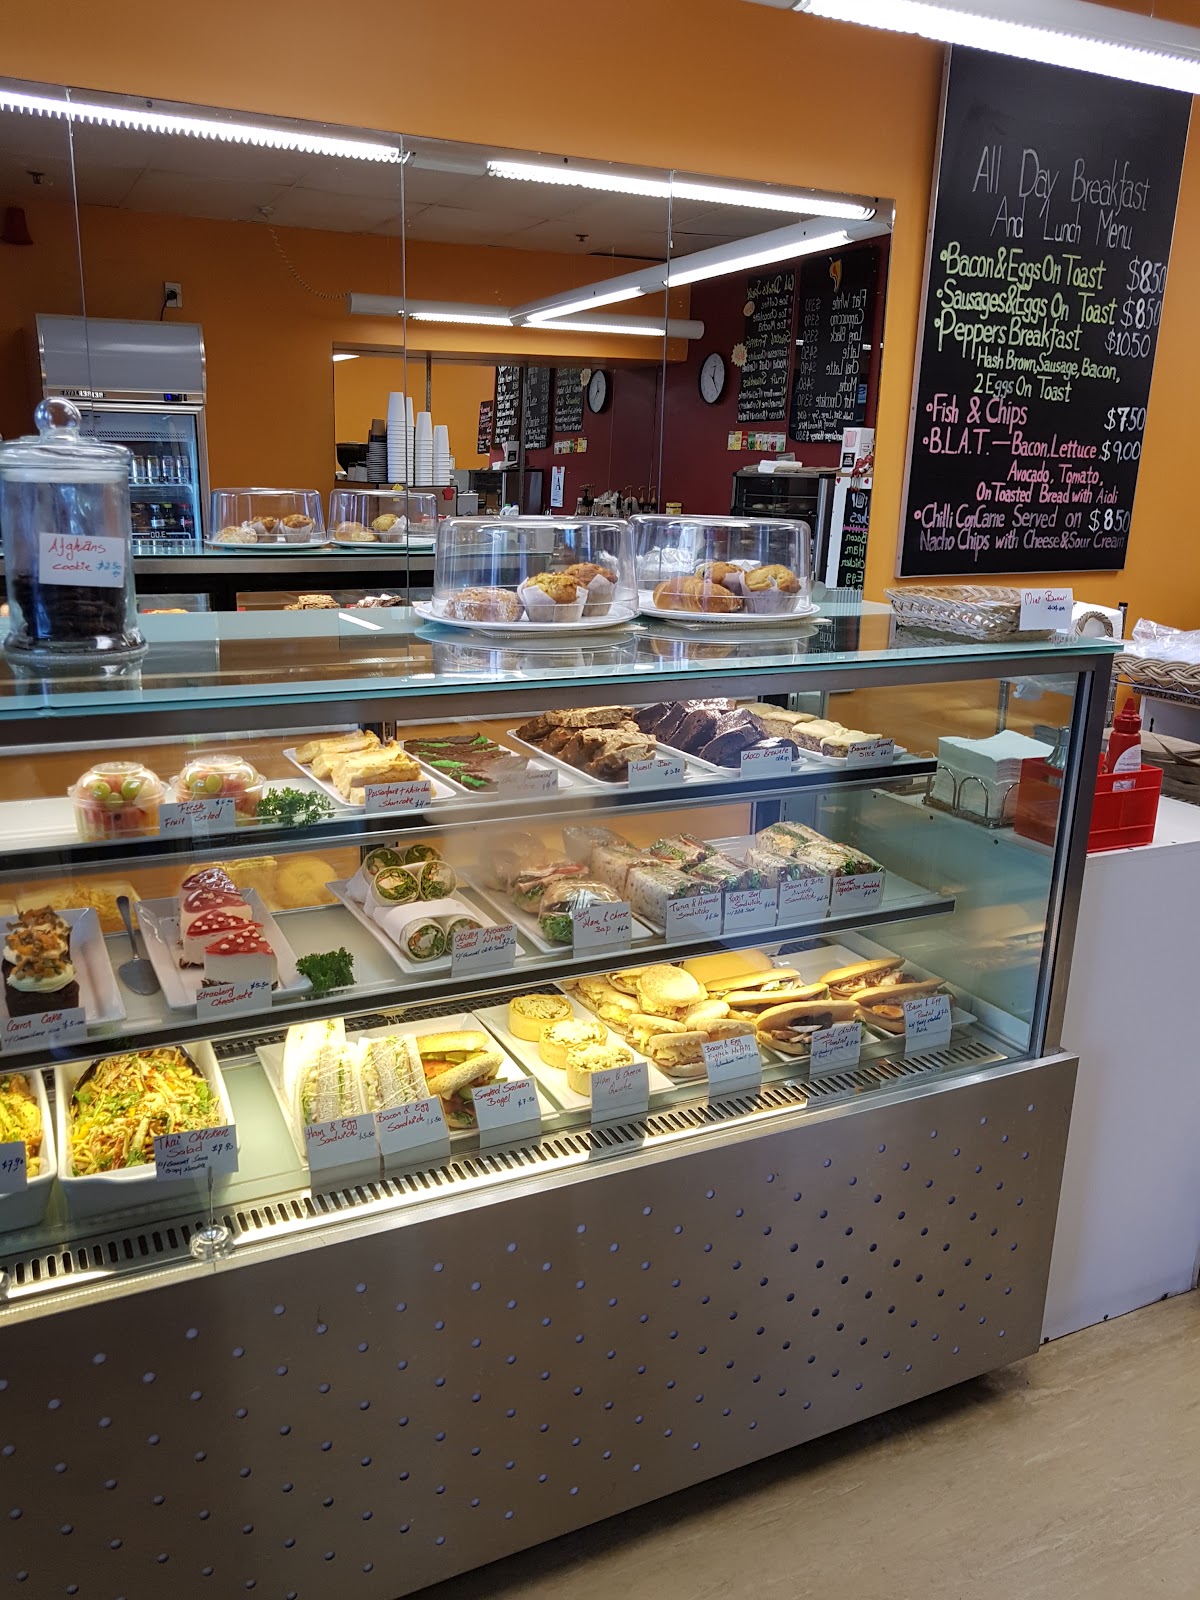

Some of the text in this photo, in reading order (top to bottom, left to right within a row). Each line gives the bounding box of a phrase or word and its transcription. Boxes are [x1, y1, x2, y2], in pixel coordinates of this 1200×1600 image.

[972, 144, 1151, 218] All Day Breakfast
[990, 195, 1133, 250] And Lunch Menu
[1062, 253, 1106, 290] Toast
[1126, 255, 1167, 294] $8.50
[1050, 292, 1069, 321] On
[1078, 292, 1118, 325] Toast
[1120, 296, 1162, 330] $8.50
[938, 307, 1151, 359] Peppers Breakfast $10.50
[977, 345, 1004, 370] Hash
[1081, 358, 1121, 383] Bacon,
[973, 373, 1073, 403] 2 Eggs On Toast
[932, 393, 1146, 434] Fish & Chips $7.50
[1011, 430, 1050, 459] Bacon,
[1101, 440, 1141, 464] $9.00
[976, 481, 1119, 504] On Toasted Bread with Aioli
[921, 503, 954, 529] Chilli
[1012, 504, 1058, 530] Served
[1065, 511, 1082, 529] on
[920, 531, 955, 552] Nacho
[957, 529, 990, 562] Chips
[995, 531, 1019, 550] with
[1093, 531, 1125, 550] Cream
[164, 807, 223, 828] Fruit Salad
[669, 902, 690, 912] Tuna
[6, 1019, 32, 1032] Carrot
[375, 1102, 430, 1123] Bacon & Egg
[487, 1093, 511, 1107] Bagel
[306, 1119, 358, 1140] Ham & Egg
[387, 1113, 426, 1132] Sandwich
[154, 1128, 230, 1151] Thai Chicken
[166, 1142, 204, 1158] Salad
[317, 1129, 358, 1147] Sandwich
